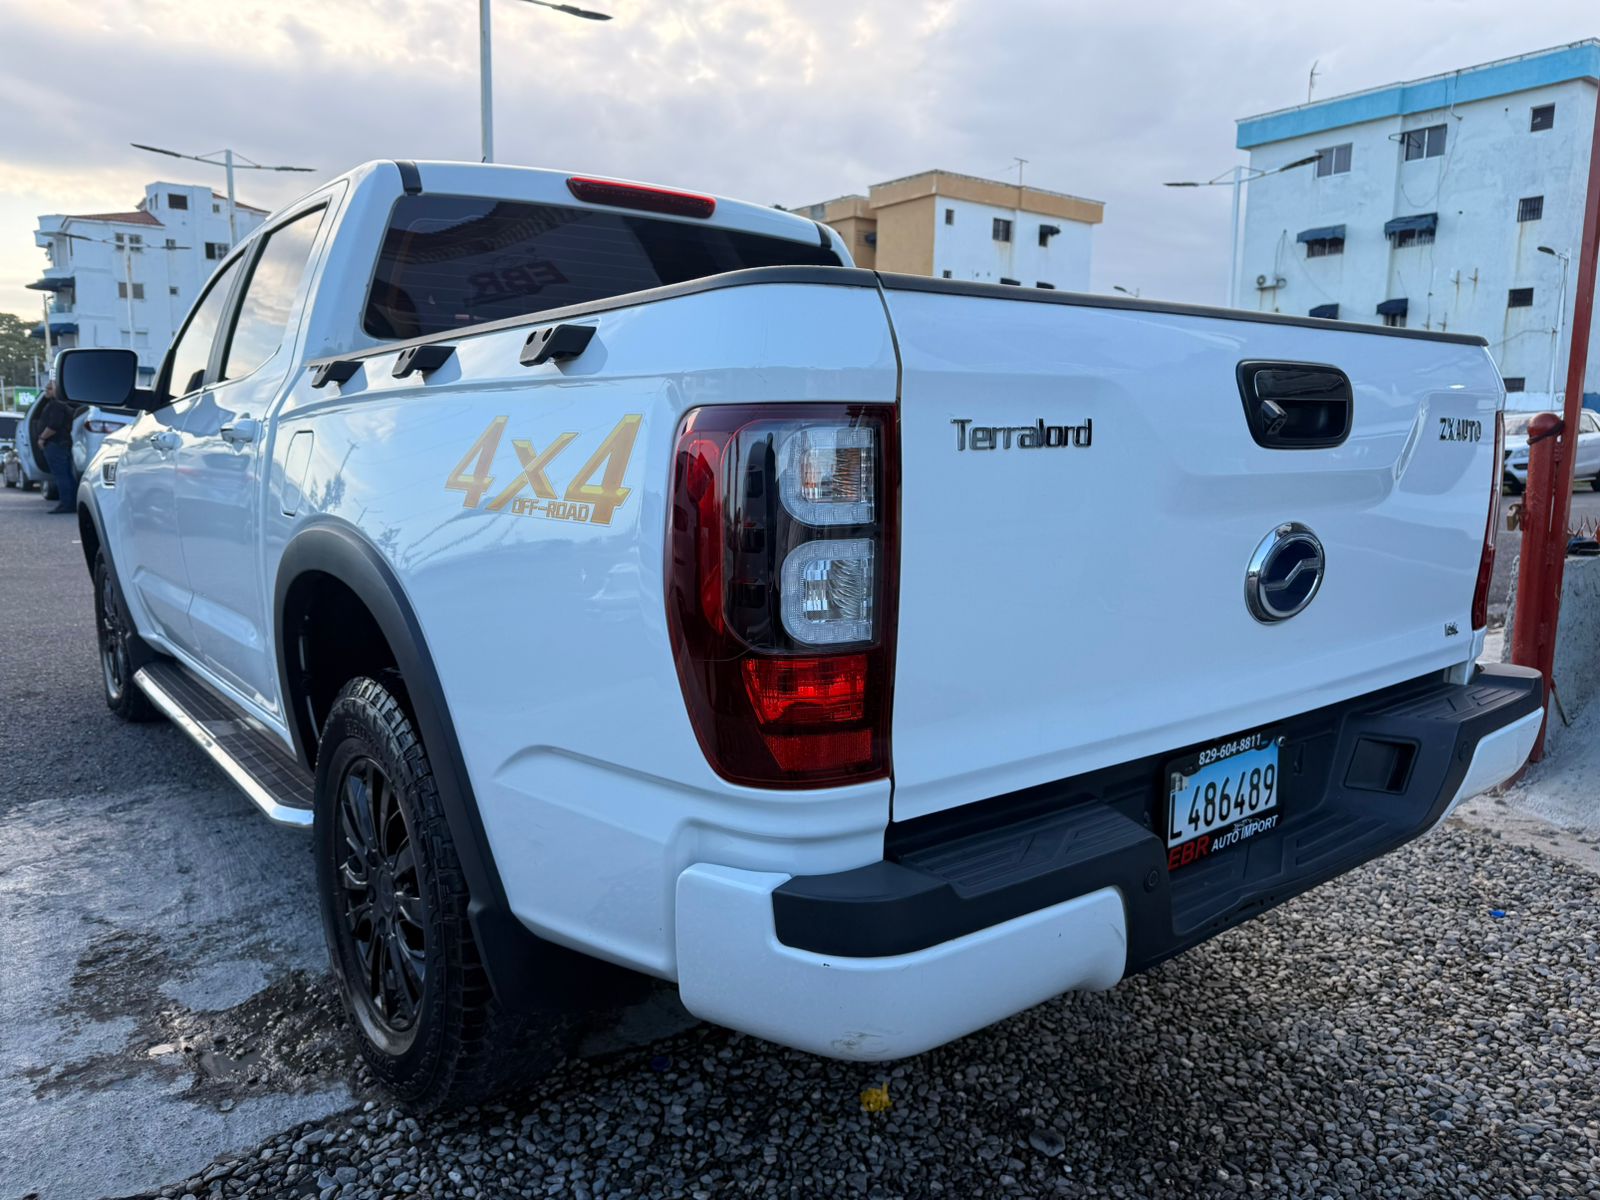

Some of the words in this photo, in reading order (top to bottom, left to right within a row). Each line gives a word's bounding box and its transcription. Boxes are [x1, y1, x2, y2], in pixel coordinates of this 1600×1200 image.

[950, 417, 1093, 451] Terralord
[511, 498, 590, 522] OFF-ROAD
[1198, 733, 1262, 765] 829-604-8811
[1167, 834, 1211, 872] EBR
[1211, 830, 1239, 852] AUTO
[1240, 814, 1279, 841] IMPORT
